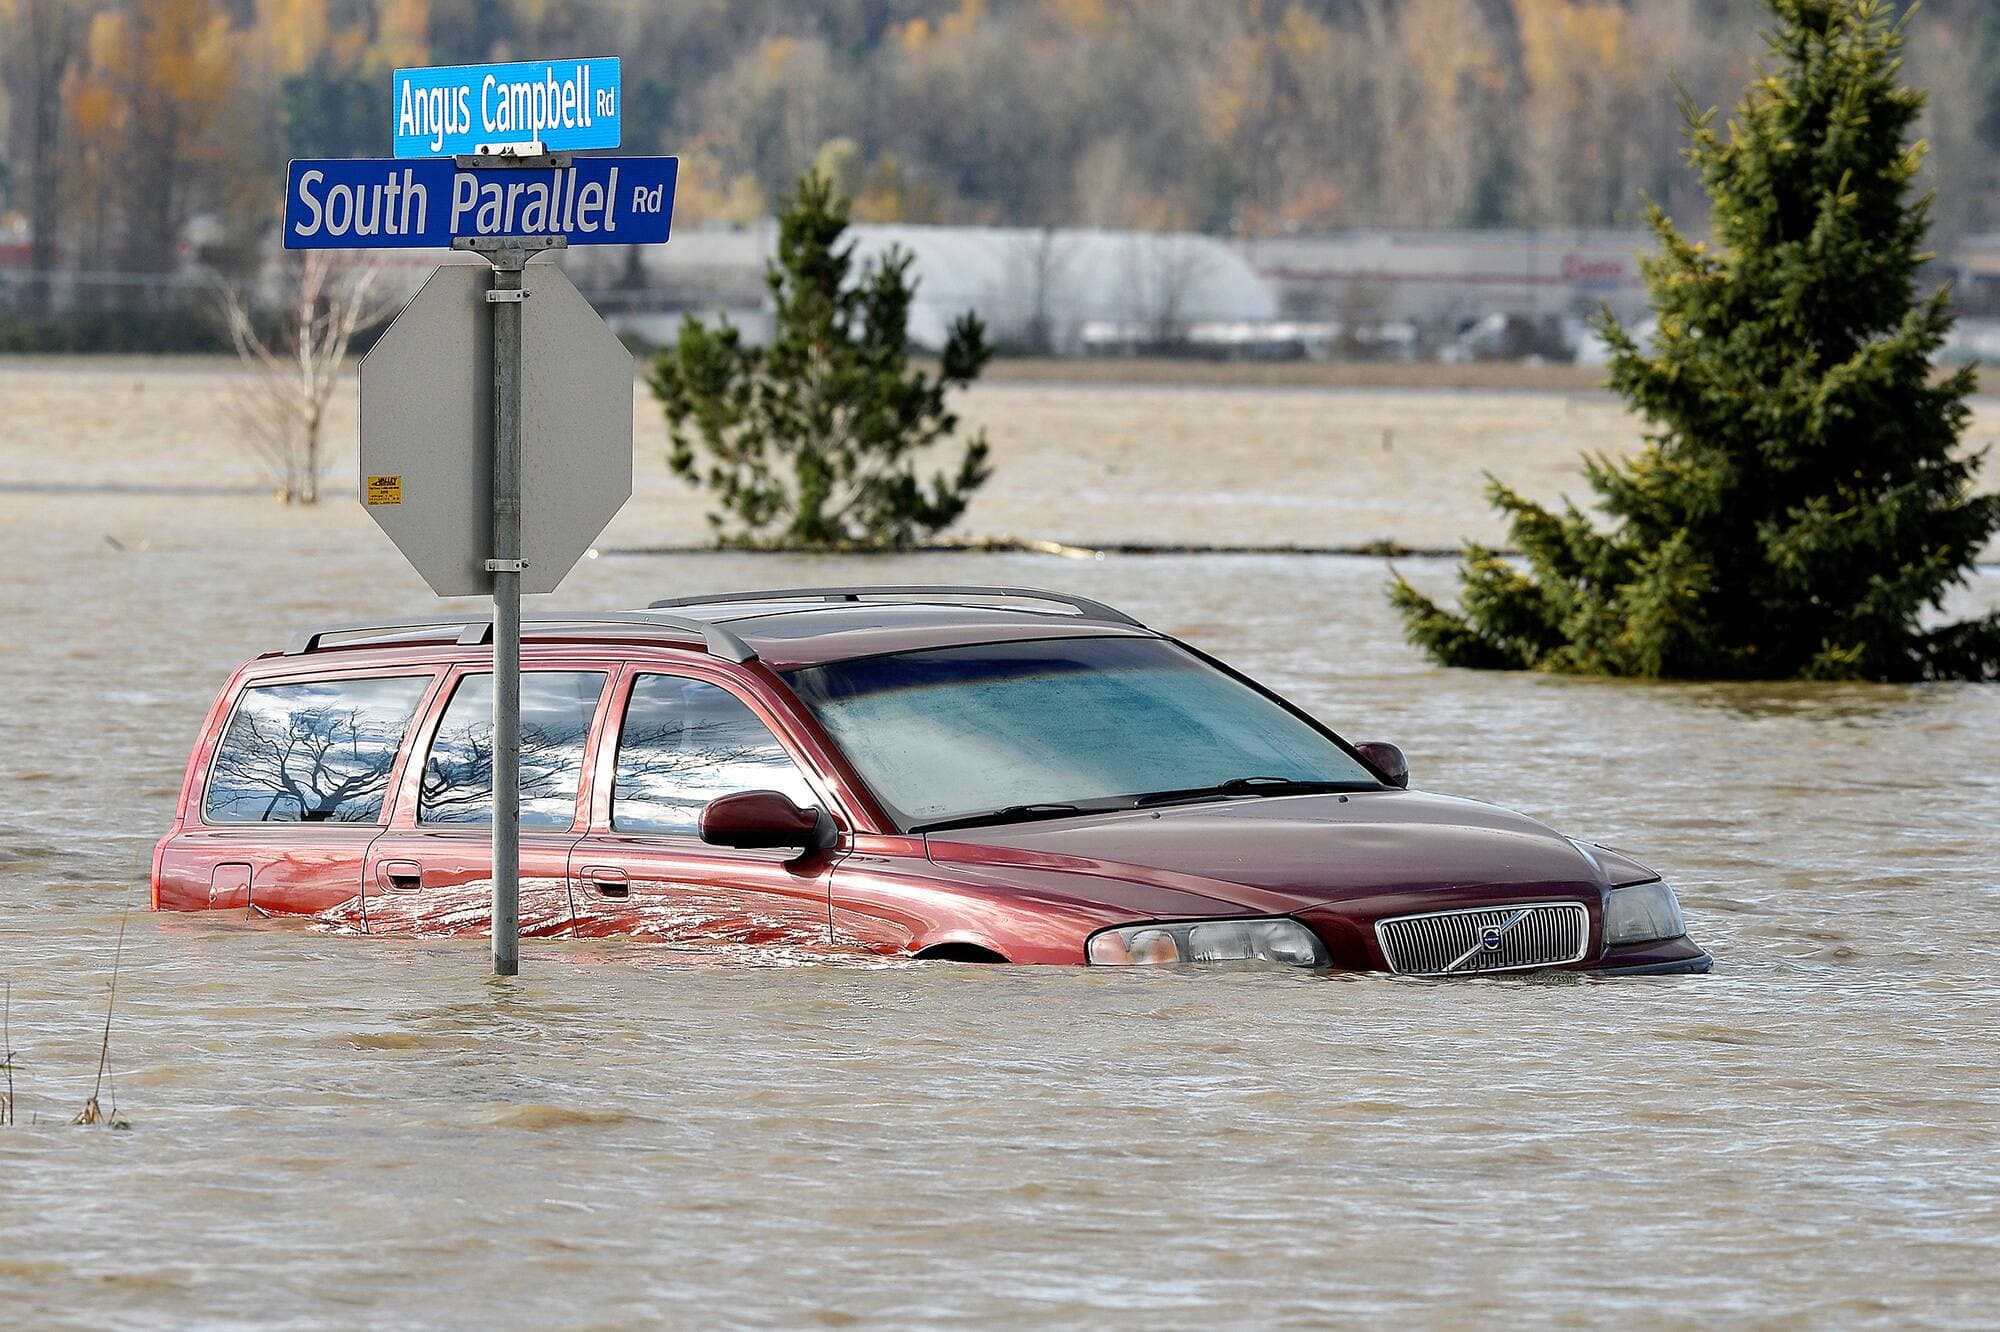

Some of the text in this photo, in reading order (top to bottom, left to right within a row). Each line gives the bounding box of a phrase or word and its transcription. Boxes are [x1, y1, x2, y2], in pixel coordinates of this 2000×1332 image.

[398, 64, 615, 152] Angus Campbell Rd
[294, 167, 663, 236] South Parallel Rd
